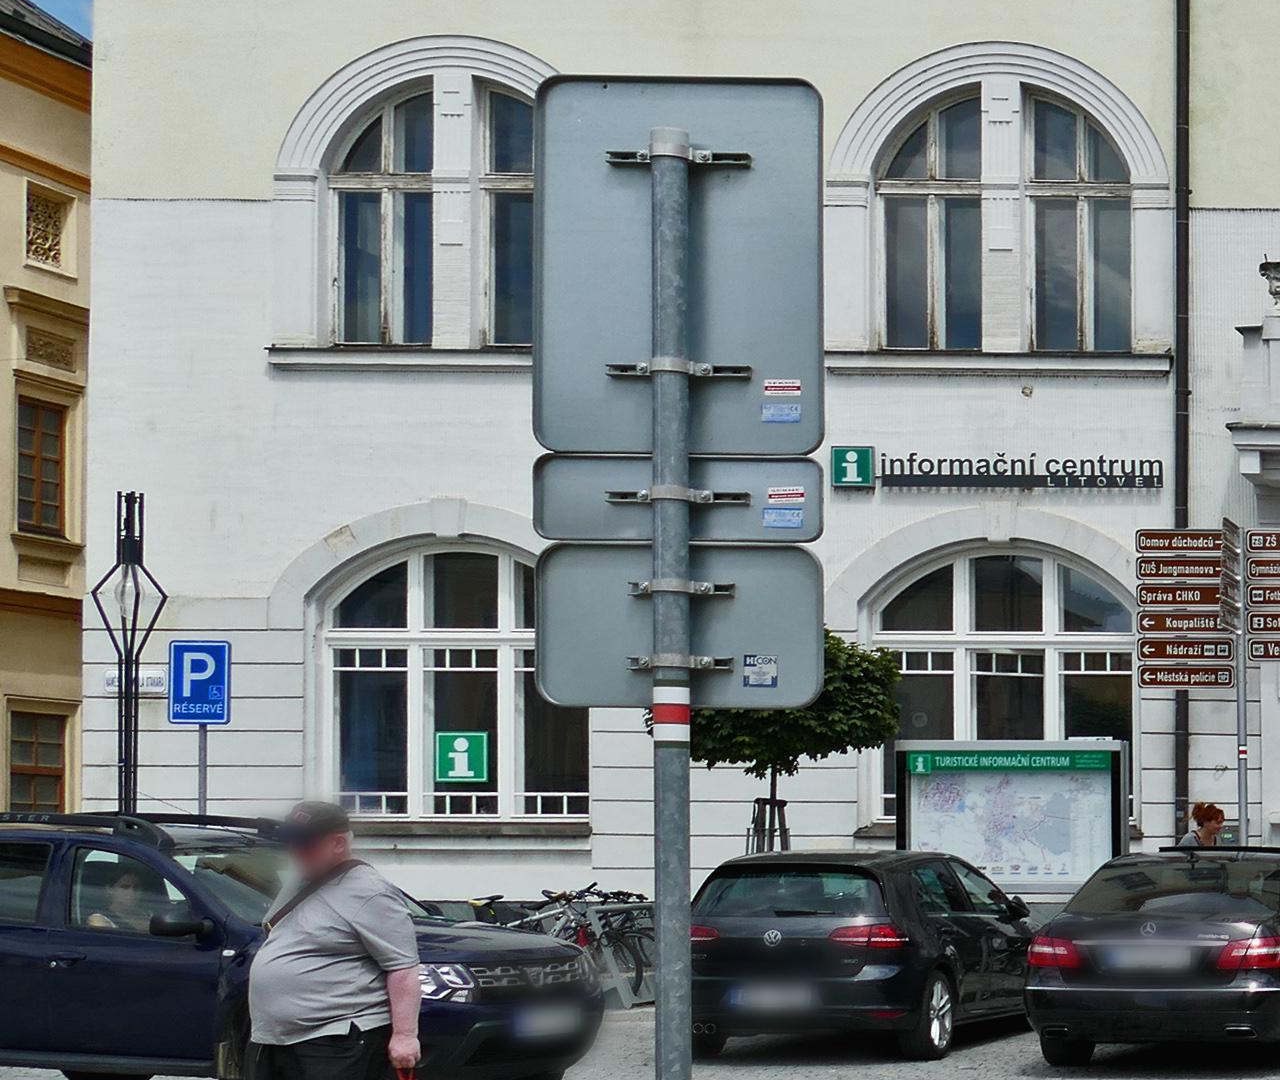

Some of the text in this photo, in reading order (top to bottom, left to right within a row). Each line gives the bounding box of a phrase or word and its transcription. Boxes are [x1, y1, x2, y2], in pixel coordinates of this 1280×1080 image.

[881, 453, 1163, 477] informační centrum
[1047, 477, 1162, 487] LITOVEL
[1140, 535, 1214, 548] Domov důchodců
[1265, 535, 1276, 548] ZŠ
[1140, 562, 1214, 577] ZUŠ Jungmannova
[1140, 589, 1200, 603] Správa CHKO
[1165, 616, 1214, 630] Koupaliště
[1166, 642, 1201, 655] Nádraží
[183, 652, 216, 697] P
[1157, 670, 1216, 684] Městská policie
[173, 700, 223, 713] RÉSERVÉ
[935, 755, 978, 767] TURISTICKÉ
[980, 754, 1029, 767] INFORMAČNÍ
[1031, 756, 1070, 767] CENTRUM
